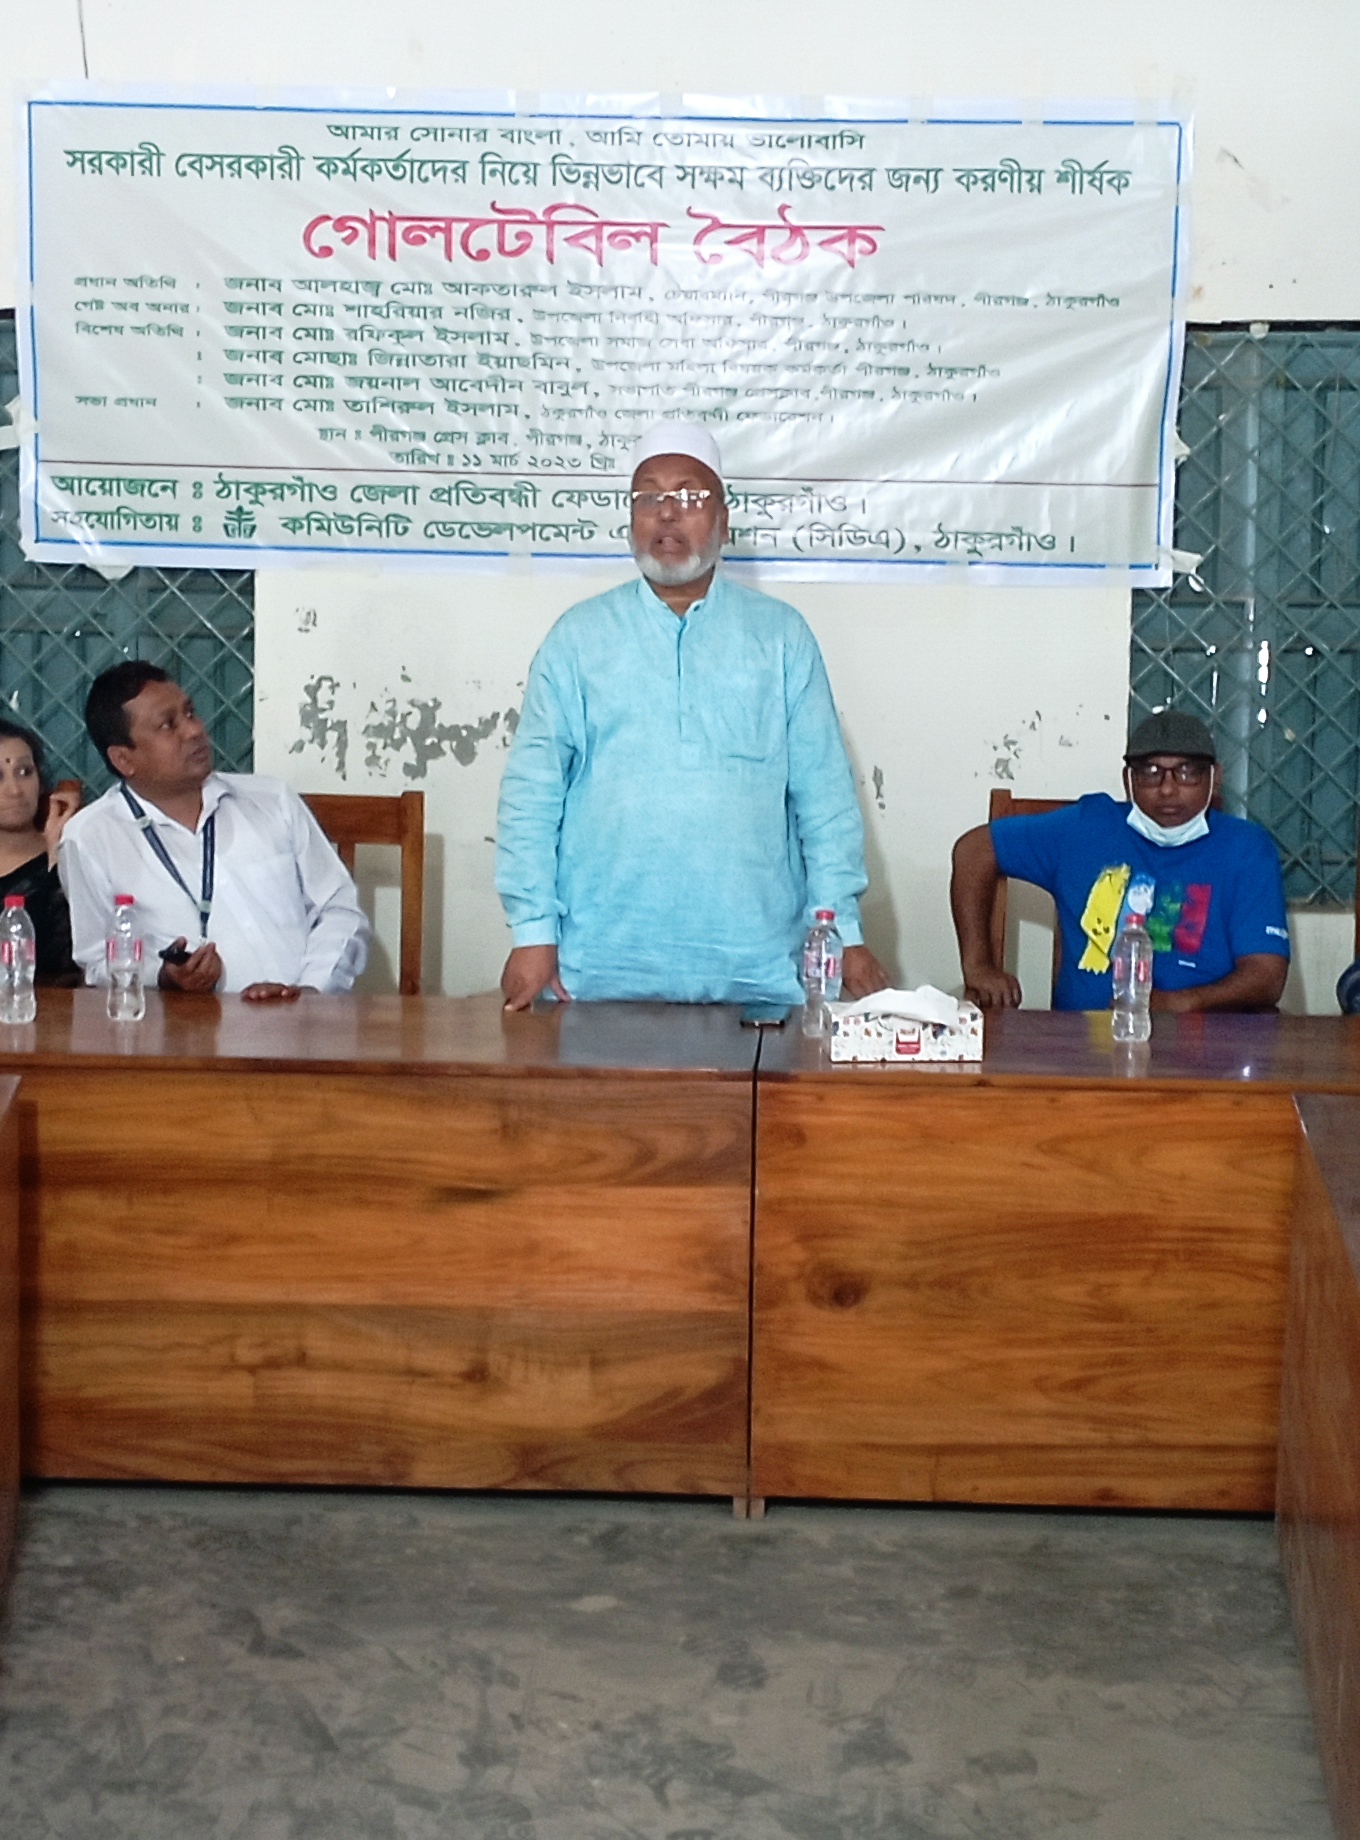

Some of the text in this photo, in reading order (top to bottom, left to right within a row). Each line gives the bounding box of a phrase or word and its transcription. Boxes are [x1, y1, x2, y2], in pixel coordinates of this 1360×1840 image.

[327, 123, 400, 144] আমার
[410, 126, 489, 146] সোনার
[586, 127, 641, 148] আমি
[652, 131, 735, 150] তোমায়
[747, 129, 866, 151] ভালোবাসি
[63, 142, 1133, 197] সরকারী বেসরকারী কর্মকর্তাদের নিয়ে ভিন্নভাবে সক্ষম ব্যক্তিদের জন্য করণীয় শীর্ষক
[302, 199, 887, 269] গোলটেবিল বৈঠক
[122, 274, 177, 289] অতিথি
[223, 277, 283, 293] জনাব
[390, 281, 434, 296] মোঃ
[222, 300, 284, 317] জনাব
[291, 303, 335, 318] মোঃ
[129, 321, 185, 338] অতিথি
[223, 325, 284, 341] জনাব
[291, 326, 335, 342] মোঃ
[343, 324, 424, 348] রফিকুল
[222, 348, 285, 365] জনাব
[222, 372, 284, 388] জনাব
[291, 373, 335, 389] মোঃ
[223, 395, 284, 412] জনাব
[291, 398, 335, 413] মোঃ
[462, 453, 483, 468] ১১
[527, 454, 583, 470] ২০২৩
[50, 475, 180, 500] আয়োজনে
[213, 472, 340, 507] ঠাকুরগাঁও
[350, 484, 420, 507] জেলা
[428, 480, 542, 510] প্রতিবন্ধী
[725, 484, 848, 520] ঠাকুরগাঁও
[279, 510, 414, 539] কমিউনিটি
[423, 517, 600, 543] ডেভেলপমেন্ট
[932, 522, 1057, 558] ঠাকুরগাঁও
